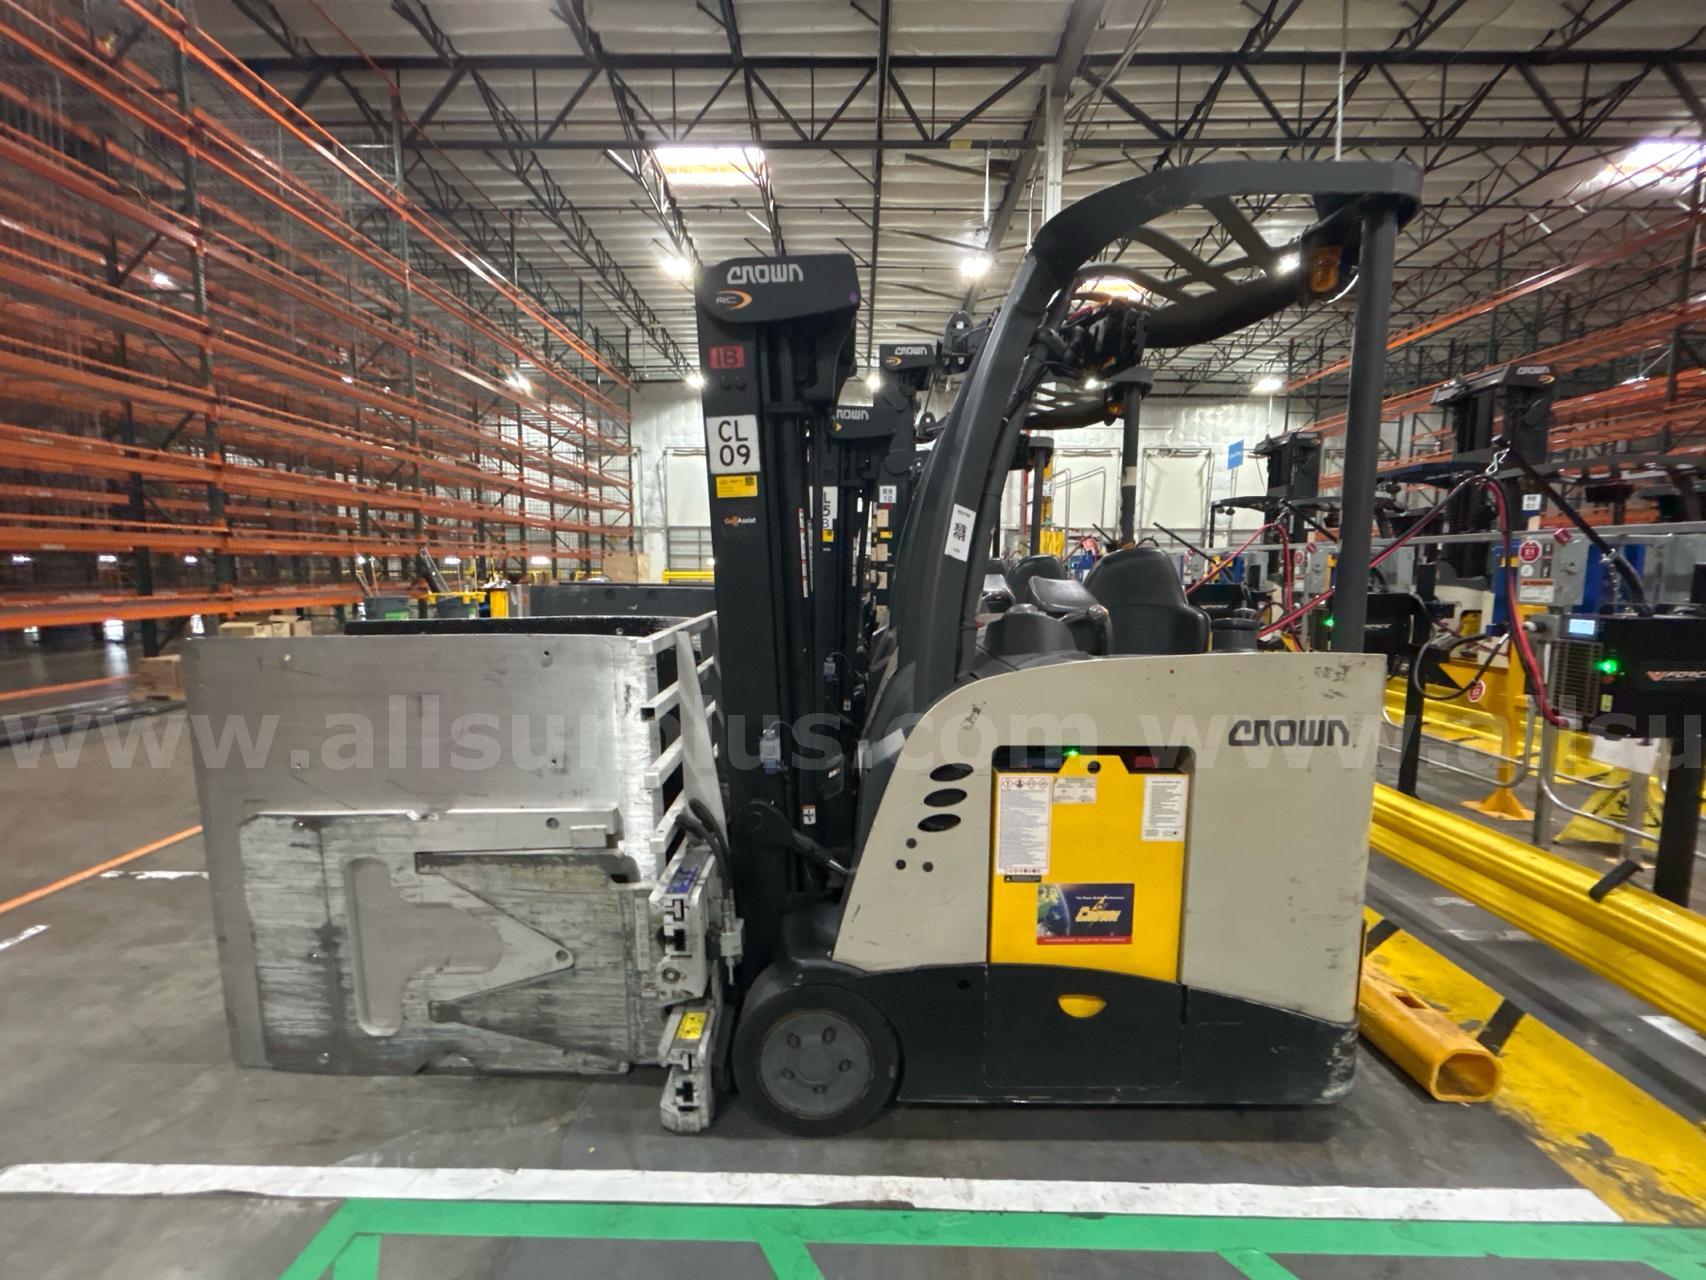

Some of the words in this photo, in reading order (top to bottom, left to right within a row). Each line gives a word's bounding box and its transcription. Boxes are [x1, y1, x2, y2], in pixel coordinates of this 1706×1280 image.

[727, 264, 804, 284] CROWN
[894, 346, 928, 356] CROWN
[835, 409, 869, 420] ROWN
[718, 420, 749, 442] CL
[719, 444, 751, 467] 09
[1228, 719, 1350, 747] CROWN
